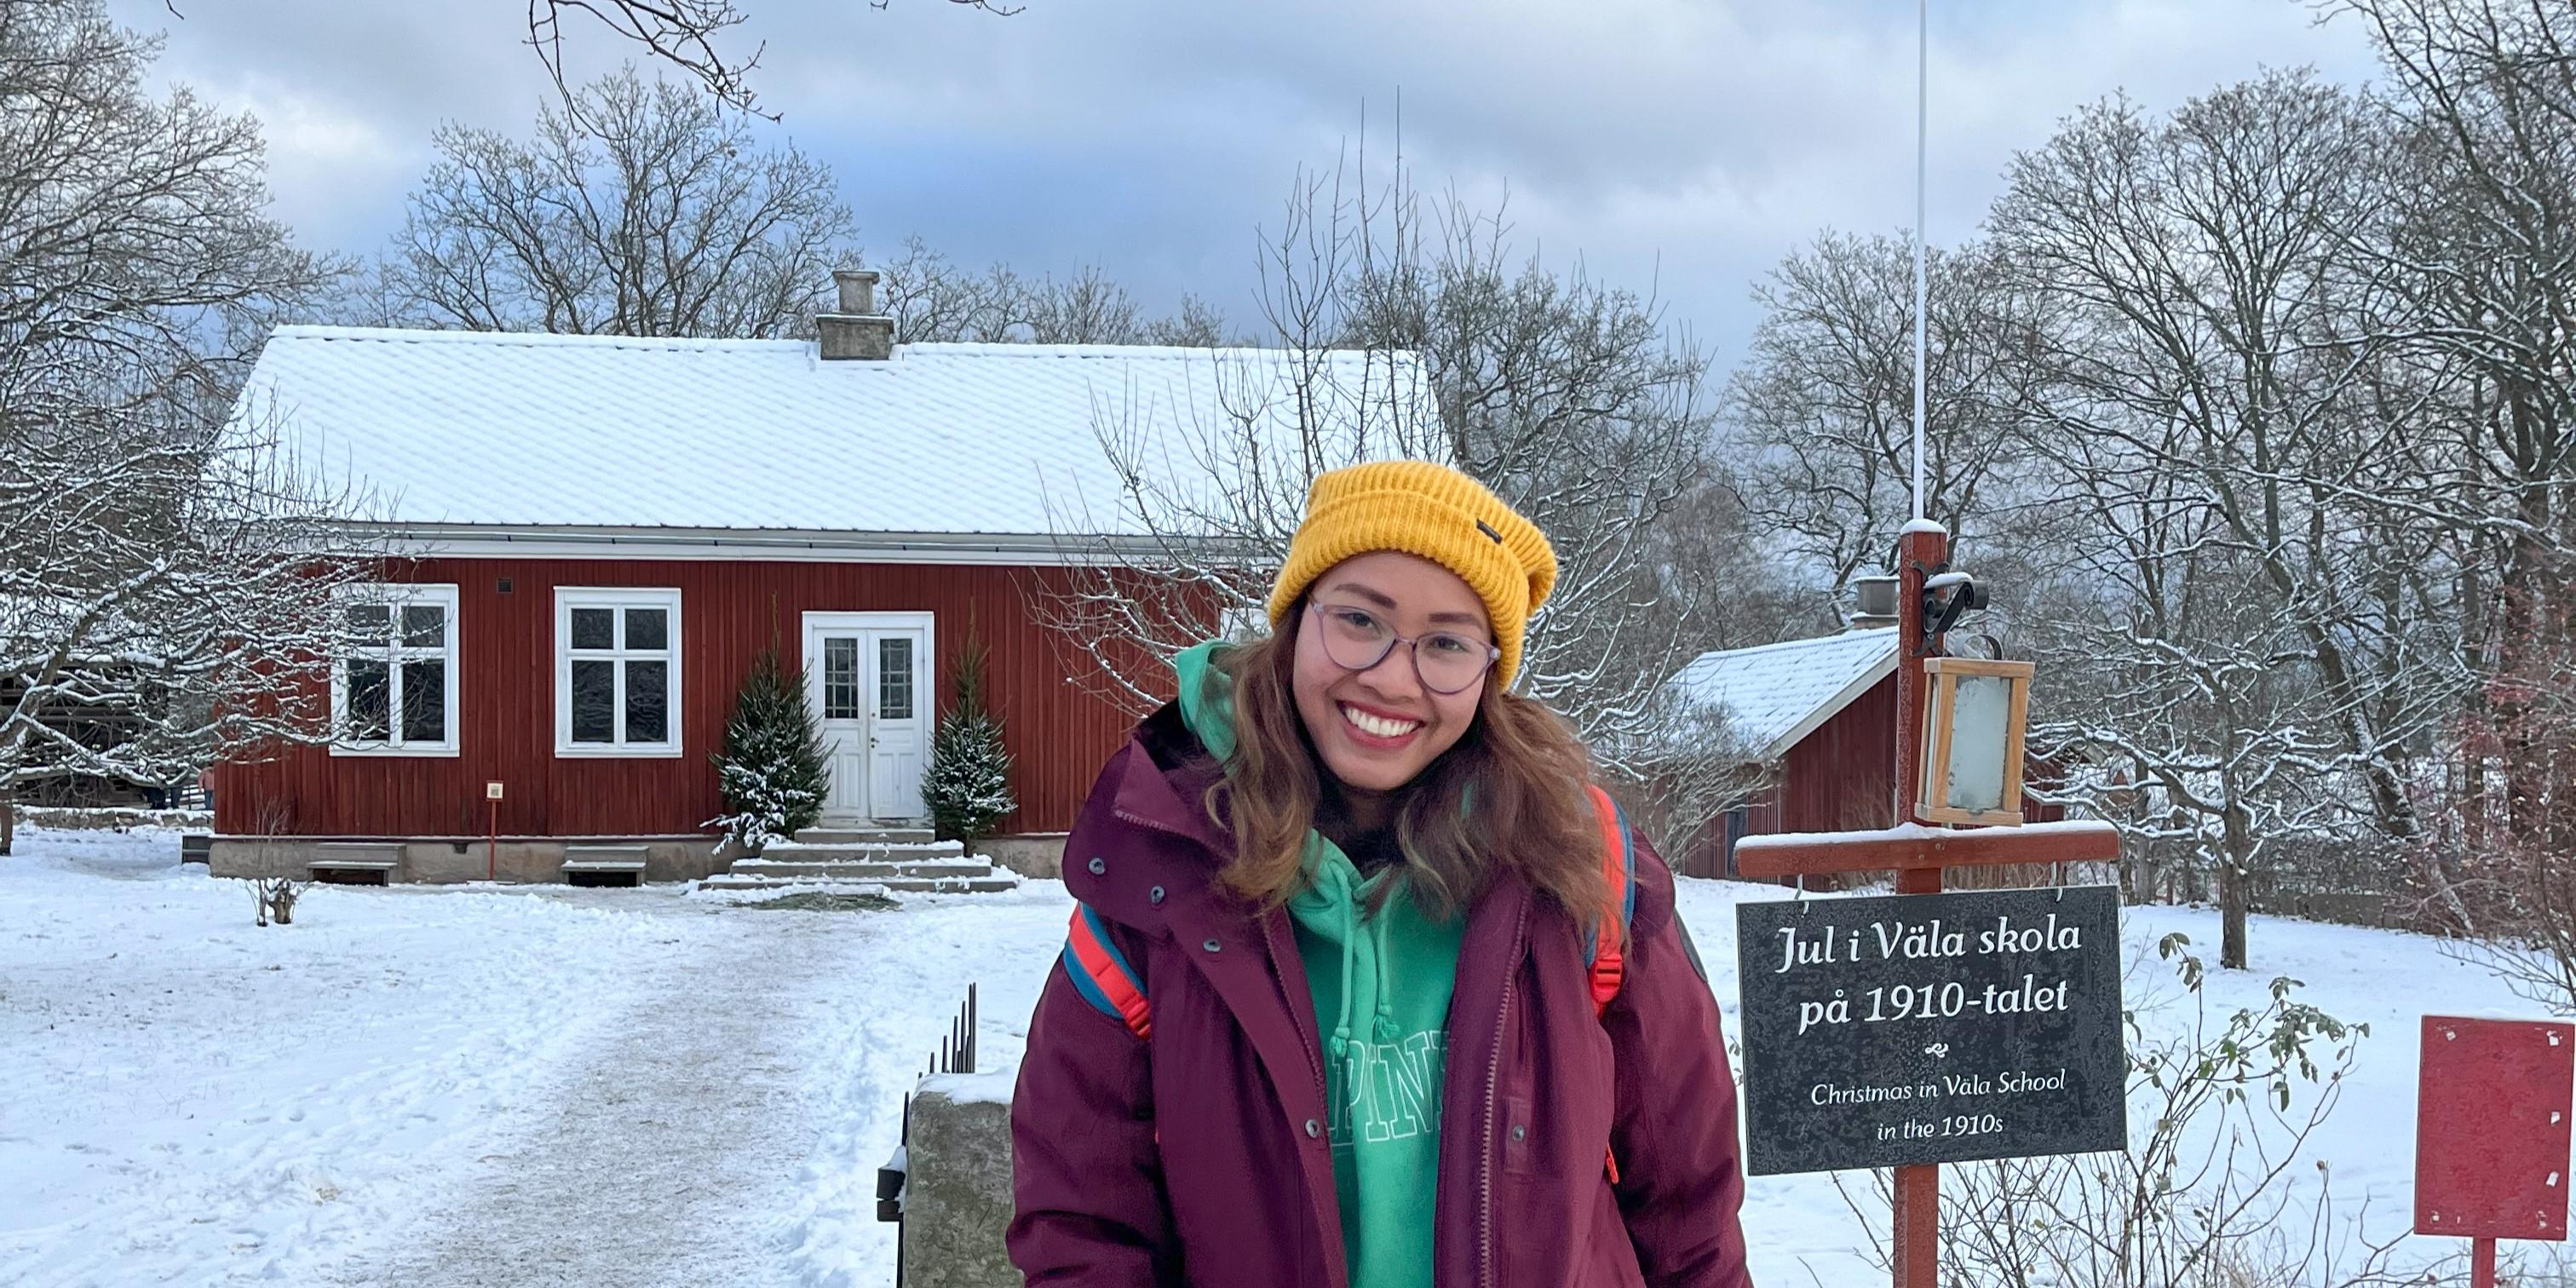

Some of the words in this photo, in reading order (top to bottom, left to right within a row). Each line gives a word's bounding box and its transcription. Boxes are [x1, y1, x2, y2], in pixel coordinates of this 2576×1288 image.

[1775, 926, 1836, 974] Jul
[1849, 930, 1860, 962] i
[1871, 920, 1966, 959] Väla
[1979, 914, 2081, 954] skola
[1798, 989, 1851, 1036] på
[1864, 974, 2068, 1024] 1910-talet
[1811, 1084, 1912, 1106] Christmas
[1919, 1084, 1939, 1098] in
[1943, 1074, 1991, 1096] Väla
[1998, 1068, 2066, 1094] School
[1877, 1123, 1896, 1141] in
[1904, 1118, 1935, 1140] the
[1941, 1114, 2004, 1136] 1910s
